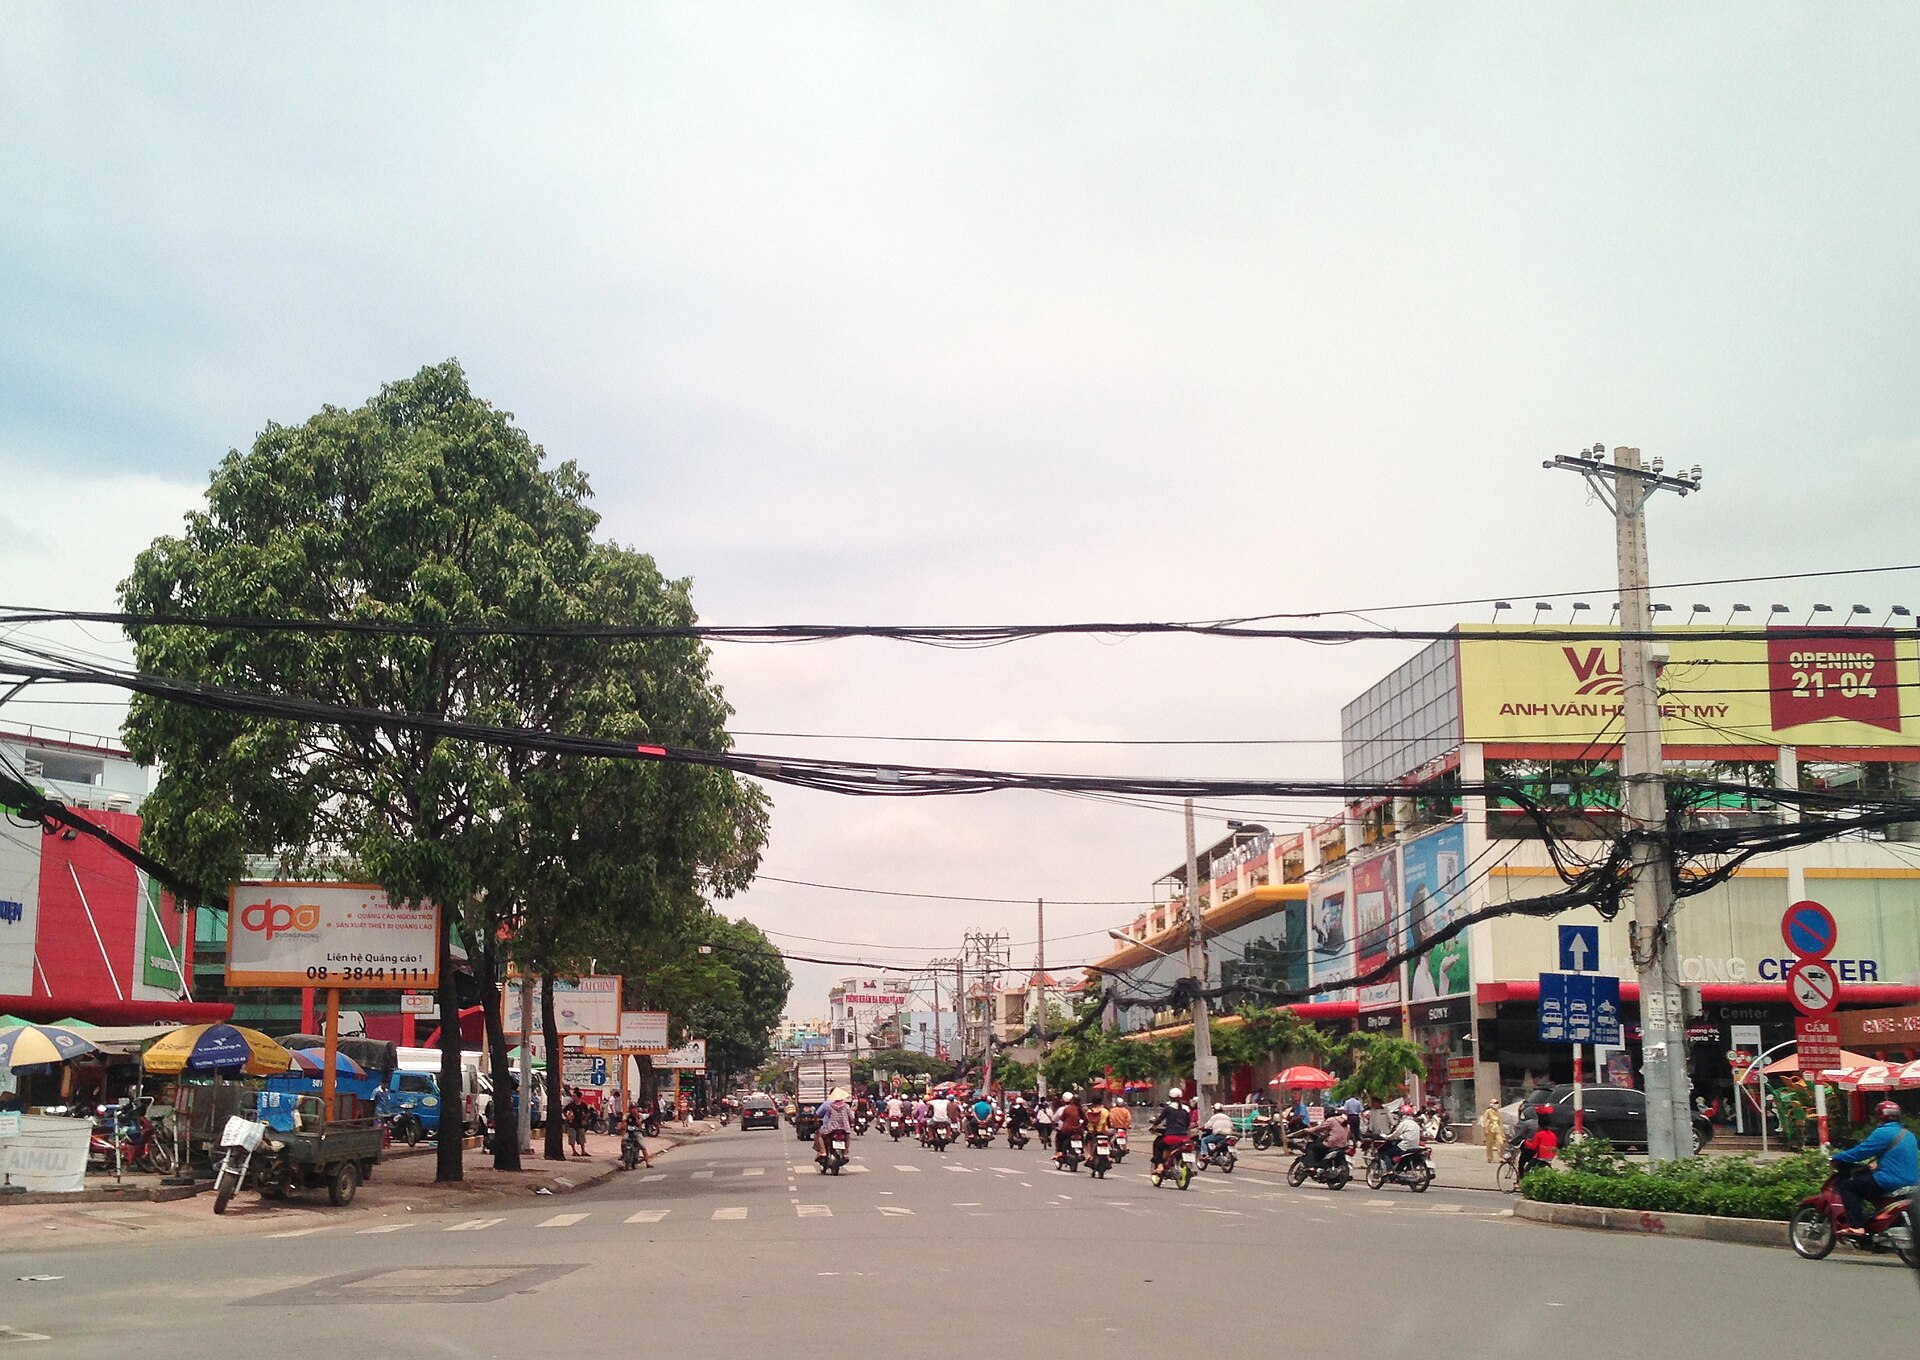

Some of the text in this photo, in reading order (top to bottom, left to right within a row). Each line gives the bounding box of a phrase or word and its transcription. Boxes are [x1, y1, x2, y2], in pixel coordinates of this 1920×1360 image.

[1789, 652, 1876, 669] OPENING
[1791, 672, 1877, 698] 21-04
[1499, 703, 1548, 716] ANH
[1550, 701, 1598, 716] VĂN
[1694, 702, 1729, 717] MỸ
[327, 952, 348, 962] Liên
[350, 952, 363, 964] hệ
[365, 953, 398, 964] Quảng
[400, 953, 417, 962] cáo
[307, 966, 328, 980] 08
[343, 967, 384, 980] 3844
[389, 968, 429, 980] 1111
[1428, 1007, 1449, 1020] SONY
[1720, 1007, 1768, 1019] Center
[1804, 1020, 1829, 1032] CẤM
[595, 1058, 604, 1070] P
